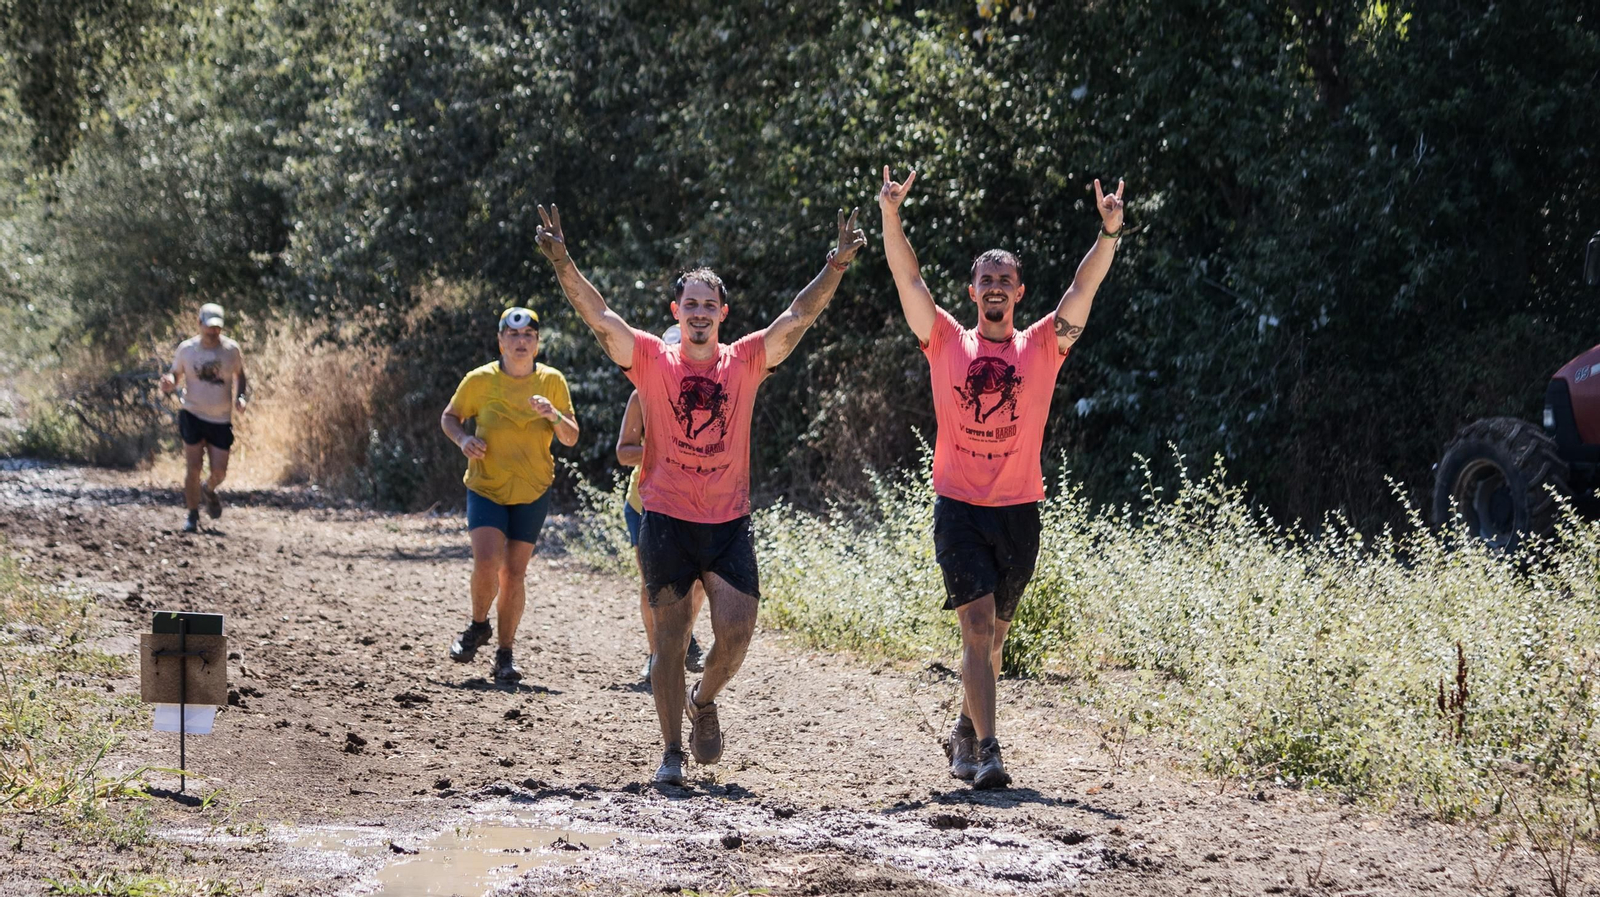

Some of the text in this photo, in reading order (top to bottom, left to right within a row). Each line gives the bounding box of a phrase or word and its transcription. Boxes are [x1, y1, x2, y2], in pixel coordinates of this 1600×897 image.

[1575, 366, 1590, 383] 95
[965, 427, 985, 437] carrera
[995, 424, 1017, 439] BARRO
